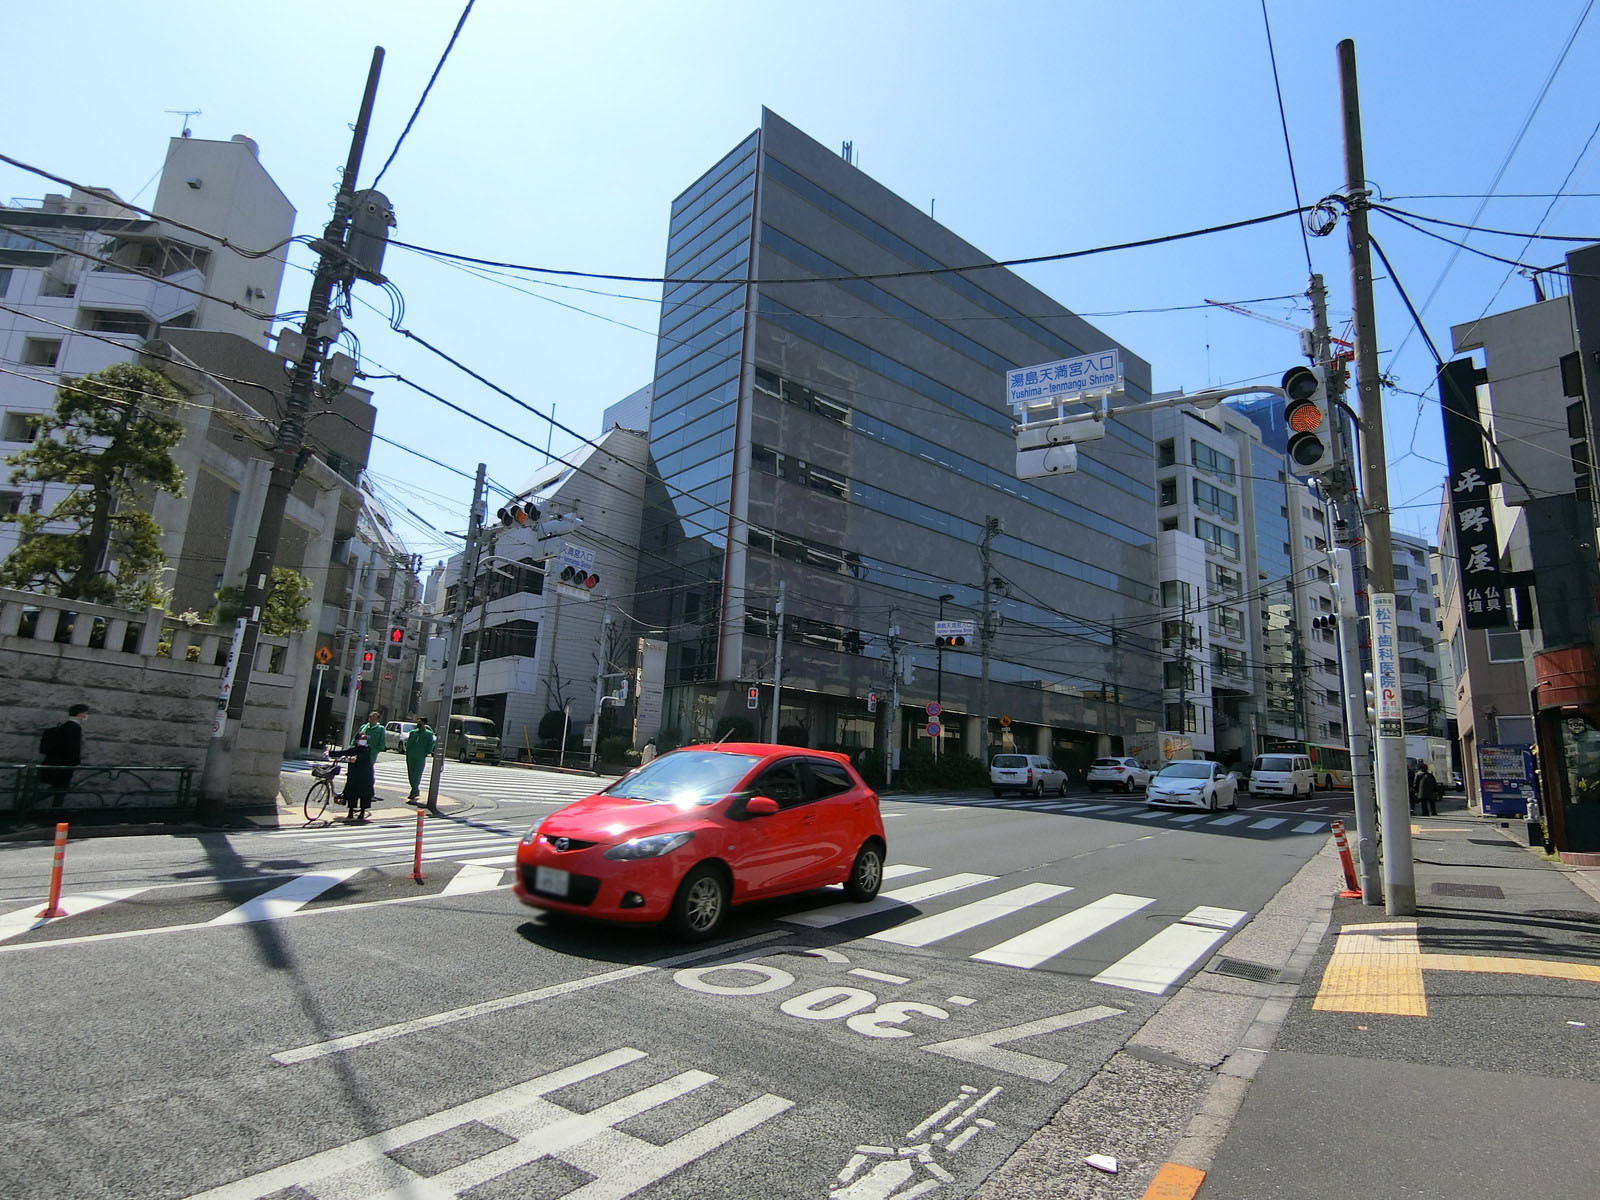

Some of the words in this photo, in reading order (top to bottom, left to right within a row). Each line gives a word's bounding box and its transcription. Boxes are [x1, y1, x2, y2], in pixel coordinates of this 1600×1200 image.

[1010, 355, 1113, 389] 湯島天満宮入口
[1089, 372, 1115, 386] Shrine
[1453, 467, 1495, 574] 平野屋
[1466, 588, 1483, 614] 仏壇
[1484, 586, 1502, 611] 仏具
[1375, 607, 1396, 689] 松下歯科医院
